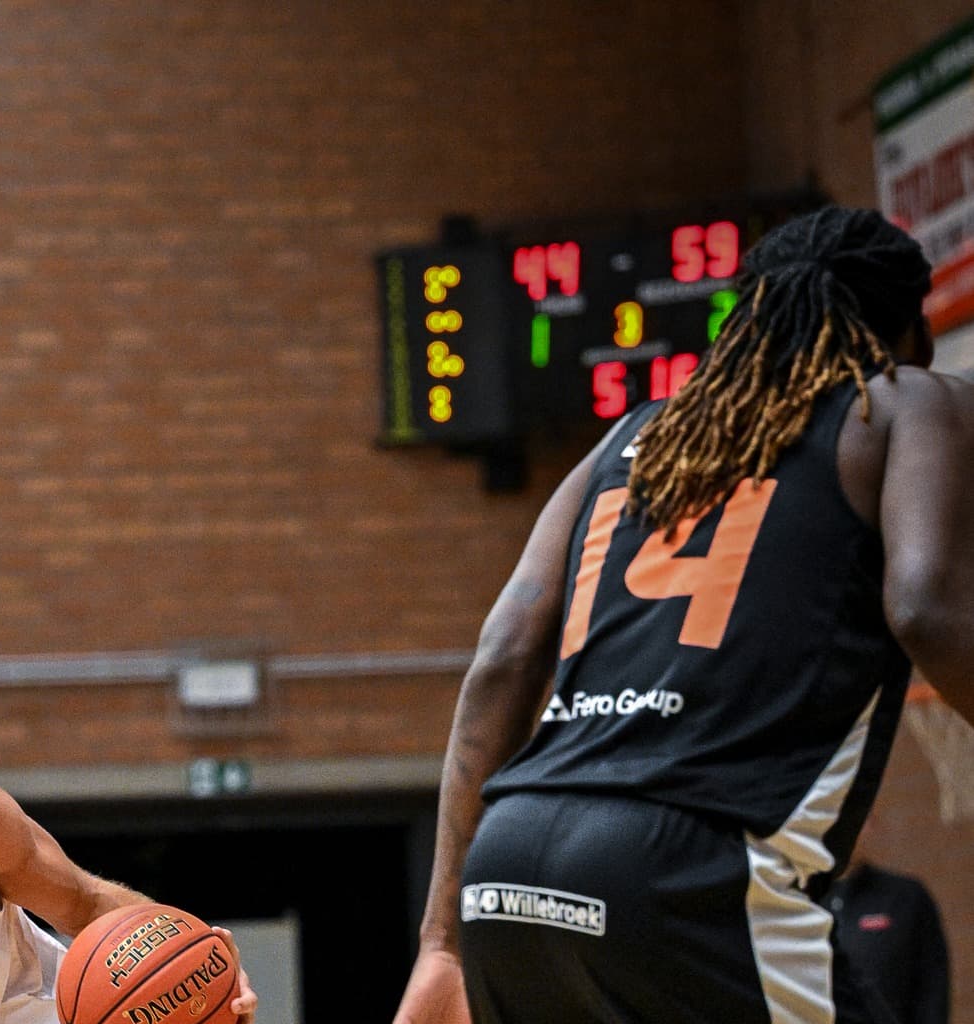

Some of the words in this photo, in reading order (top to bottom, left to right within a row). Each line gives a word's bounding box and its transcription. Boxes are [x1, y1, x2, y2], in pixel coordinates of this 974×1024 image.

[513, 241, 580, 301] 44
[672, 221, 739, 283] 59
[531, 313, 551, 368] 1
[613, 301, 643, 348] 3
[560, 478, 778, 660] 14
[500, 889, 601, 930] Willebroek
[110, 918, 193, 988] LEGACY
